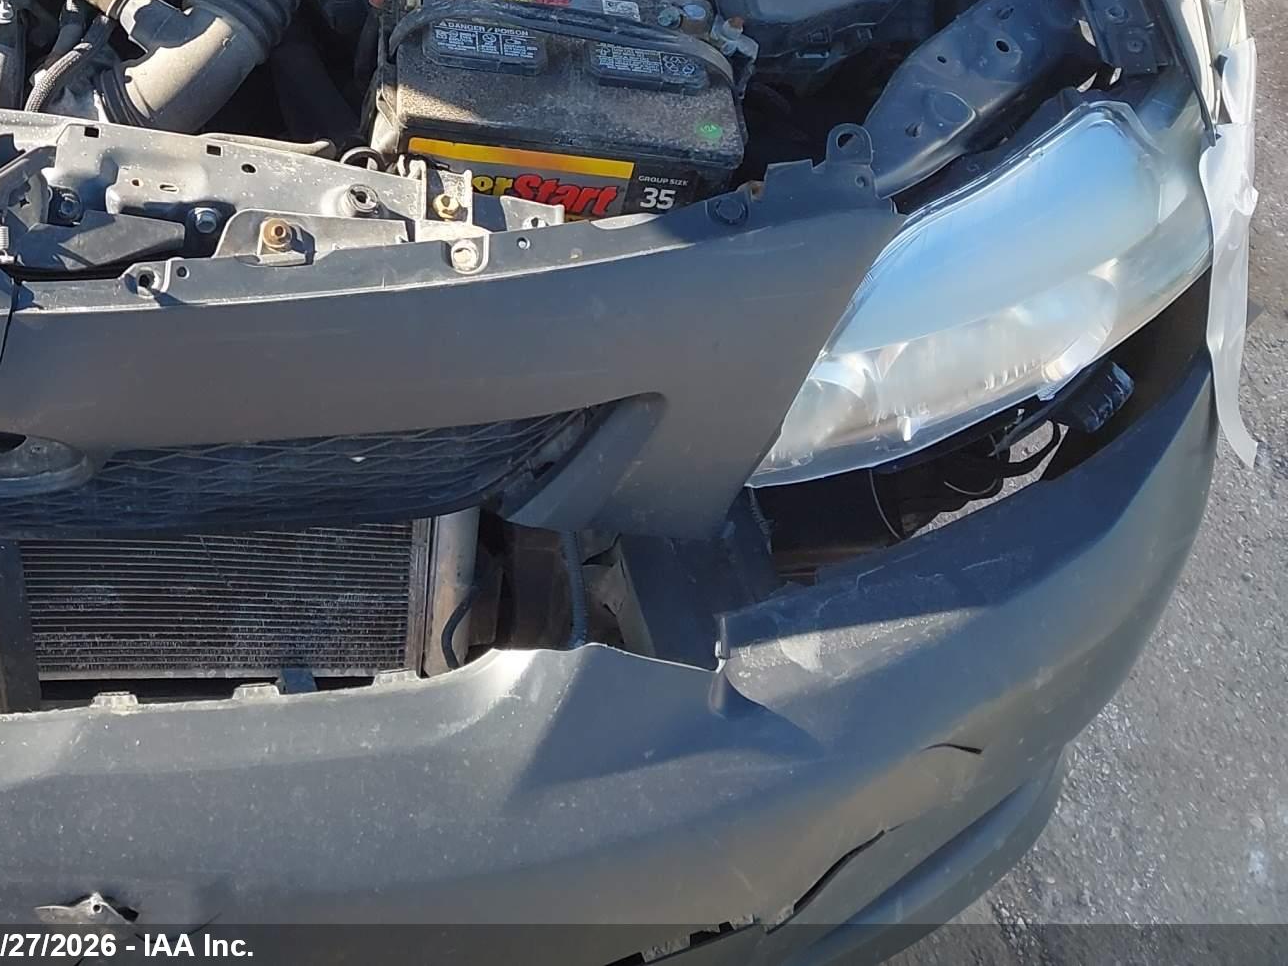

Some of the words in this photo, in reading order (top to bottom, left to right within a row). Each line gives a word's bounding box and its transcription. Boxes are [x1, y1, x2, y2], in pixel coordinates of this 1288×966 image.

[448, 22, 485, 33] DANGER
[495, 27, 529, 37] POISON
[638, 175, 668, 184] GROUP
[669, 178, 689, 187] SIZE
[639, 187, 676, 210] 35
